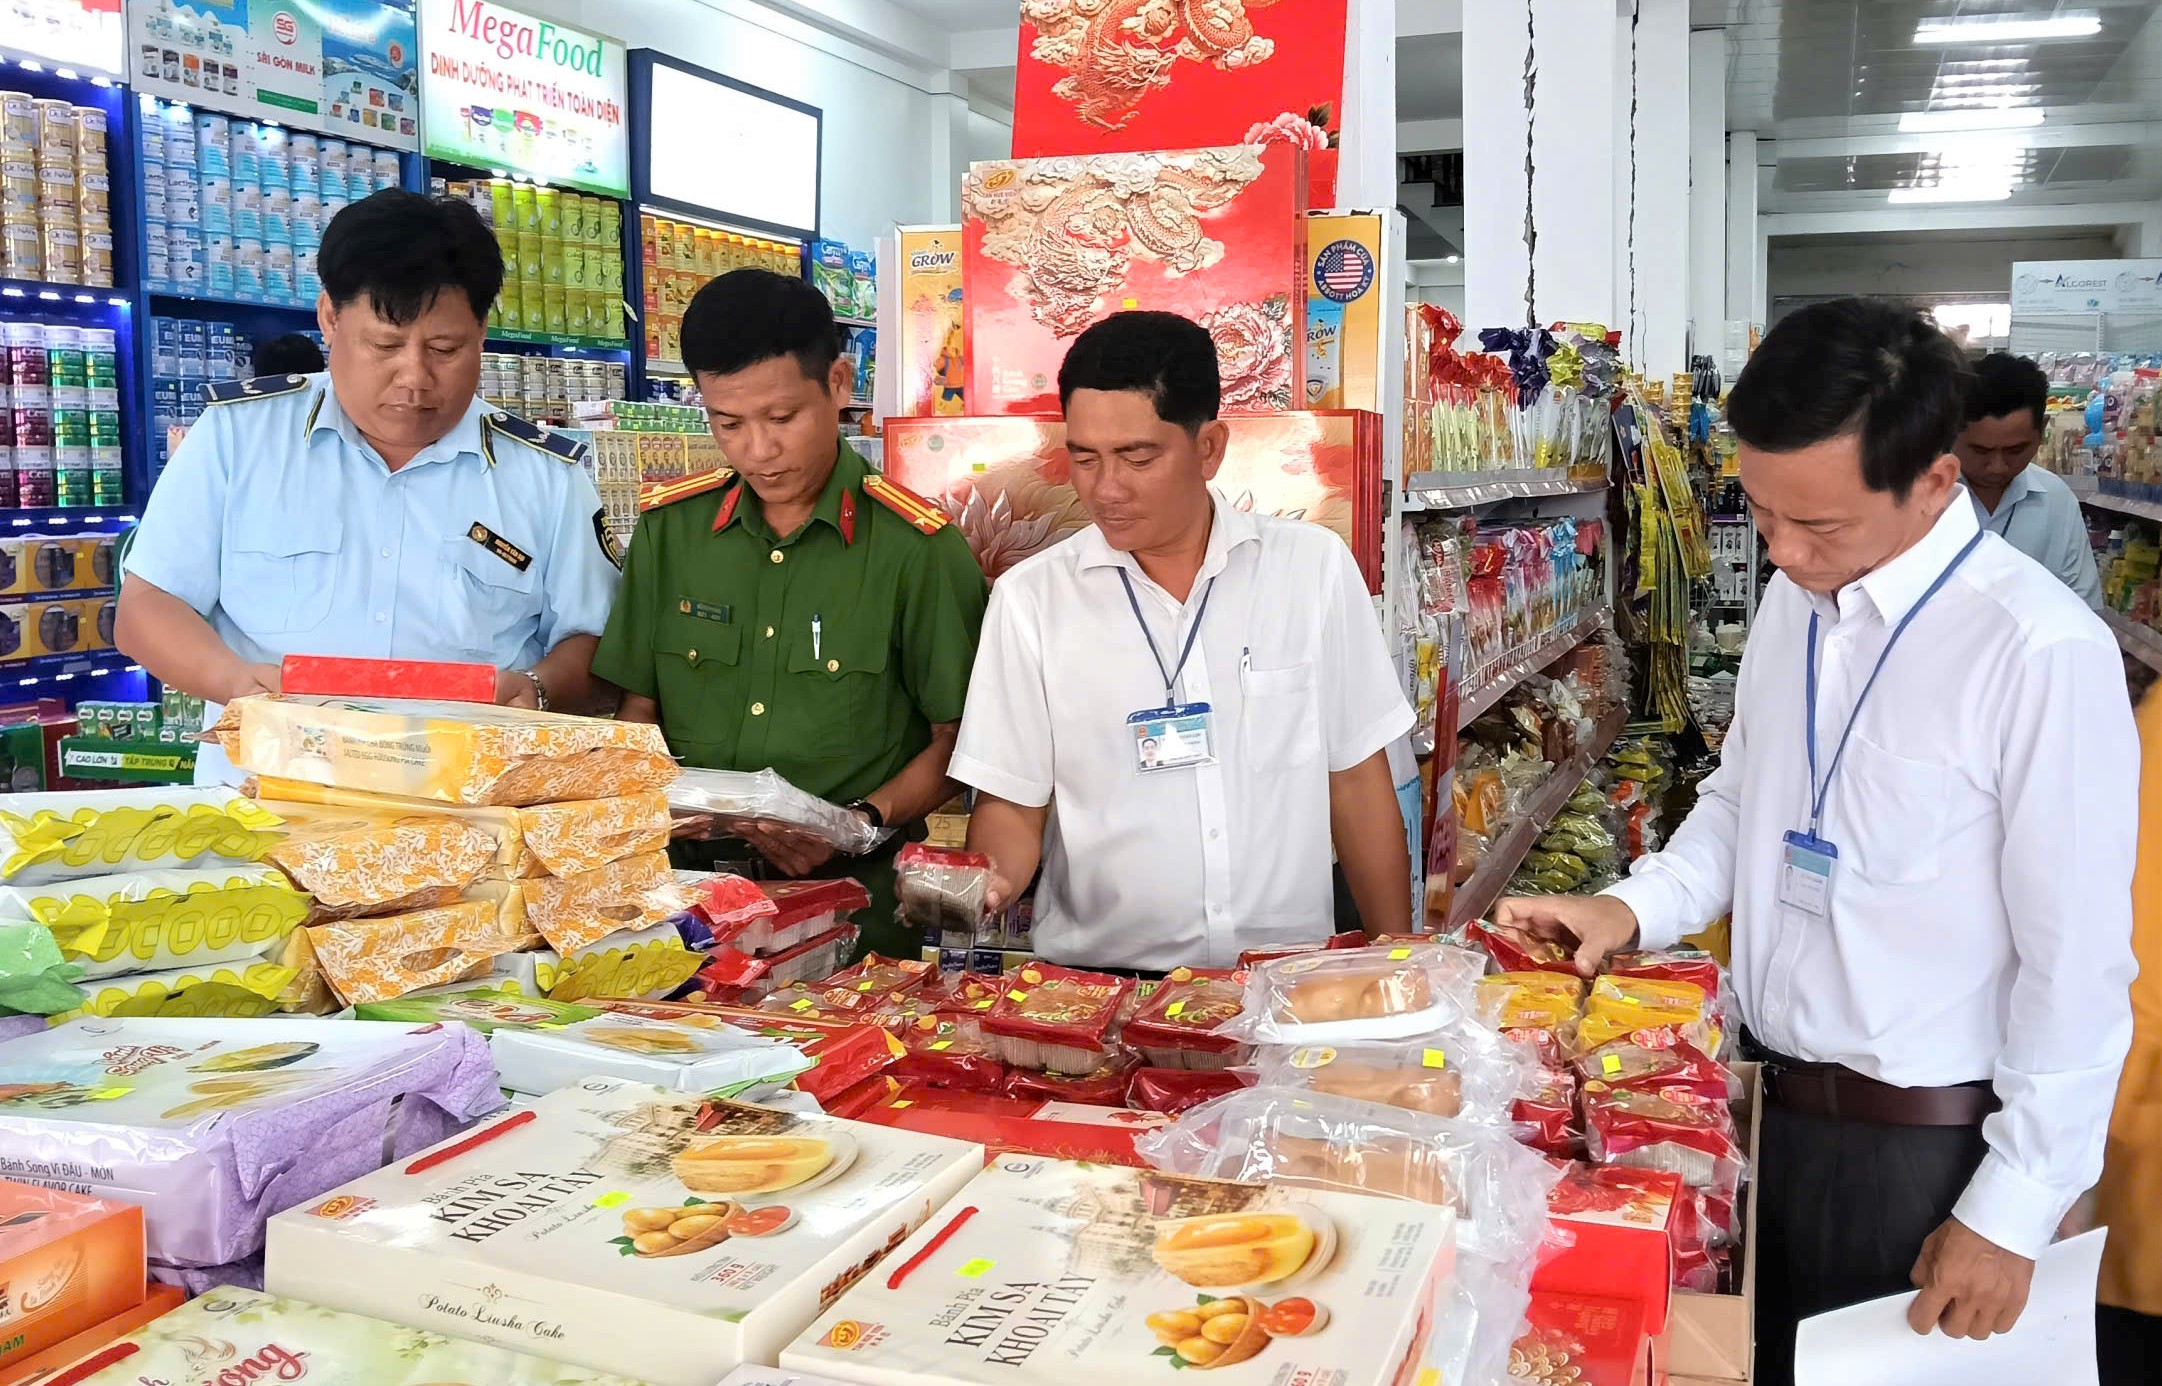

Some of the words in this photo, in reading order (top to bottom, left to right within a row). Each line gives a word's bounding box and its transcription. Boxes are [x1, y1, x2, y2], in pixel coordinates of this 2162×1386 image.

[449, 0, 603, 77] MegaFood
[273, 55, 293, 71] GÒN
[295, 61, 315, 76] MILK
[431, 52, 459, 81] DINH
[911, 252, 954, 268] GROW
[1317, 279, 1344, 300] ABBOTT
[1345, 287, 1364, 300] HOA
[1306, 325, 1337, 342] ROW
[0, 1157, 25, 1171] Bánh
[27, 1160, 51, 1177] Song
[430, 1190, 507, 1224] KIM
[494, 1172, 550, 1191] SA
[450, 1194, 557, 1243] KHOAI
[538, 1167, 606, 1195] TÂY
[419, 1293, 468, 1318] Potato
[472, 1302, 523, 1330] Liusha
[526, 1320, 566, 1340] Cake
[929, 1303, 969, 1328] Bánh
[944, 1305, 1014, 1348] KIM
[990, 1282, 1040, 1304] SA
[984, 1307, 1067, 1367] KHOAI
[1040, 1270, 1097, 1304] TÂY
